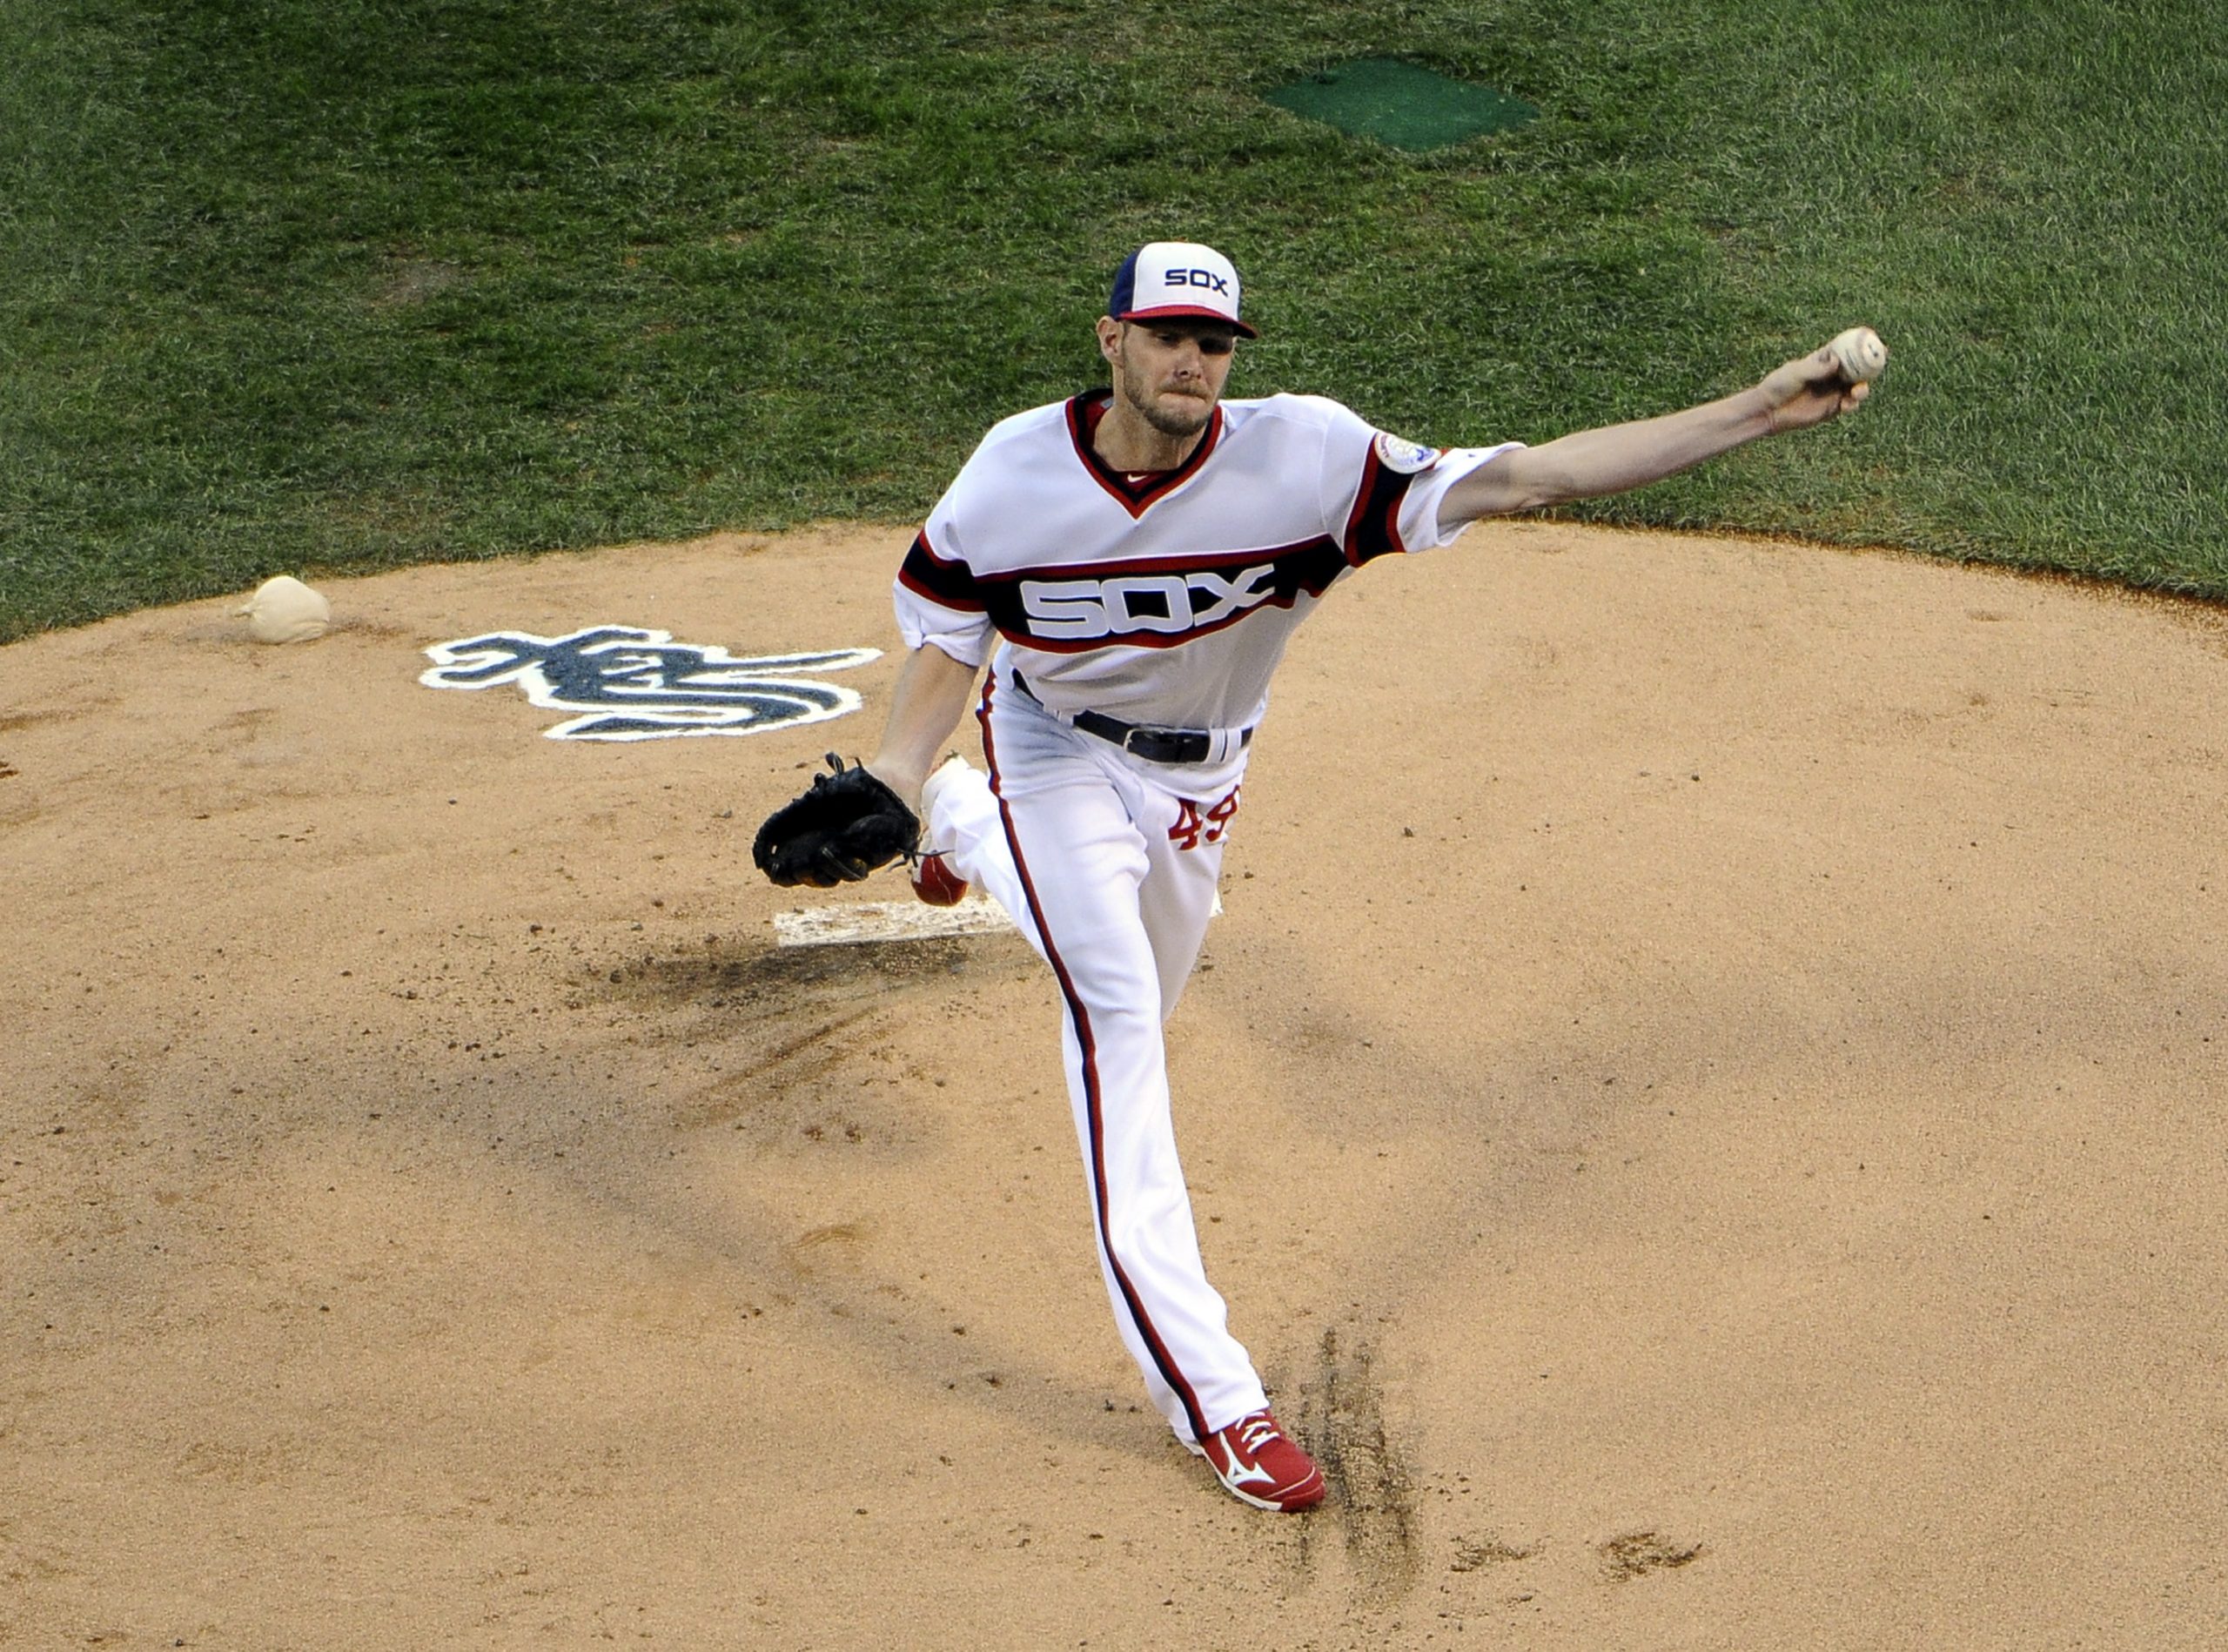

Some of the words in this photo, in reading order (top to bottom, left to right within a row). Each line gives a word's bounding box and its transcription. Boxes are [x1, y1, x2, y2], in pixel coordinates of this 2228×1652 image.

[1164, 269, 1228, 297] SOX
[1020, 563, 1275, 639] SOX
[1168, 784, 1239, 850] 49
